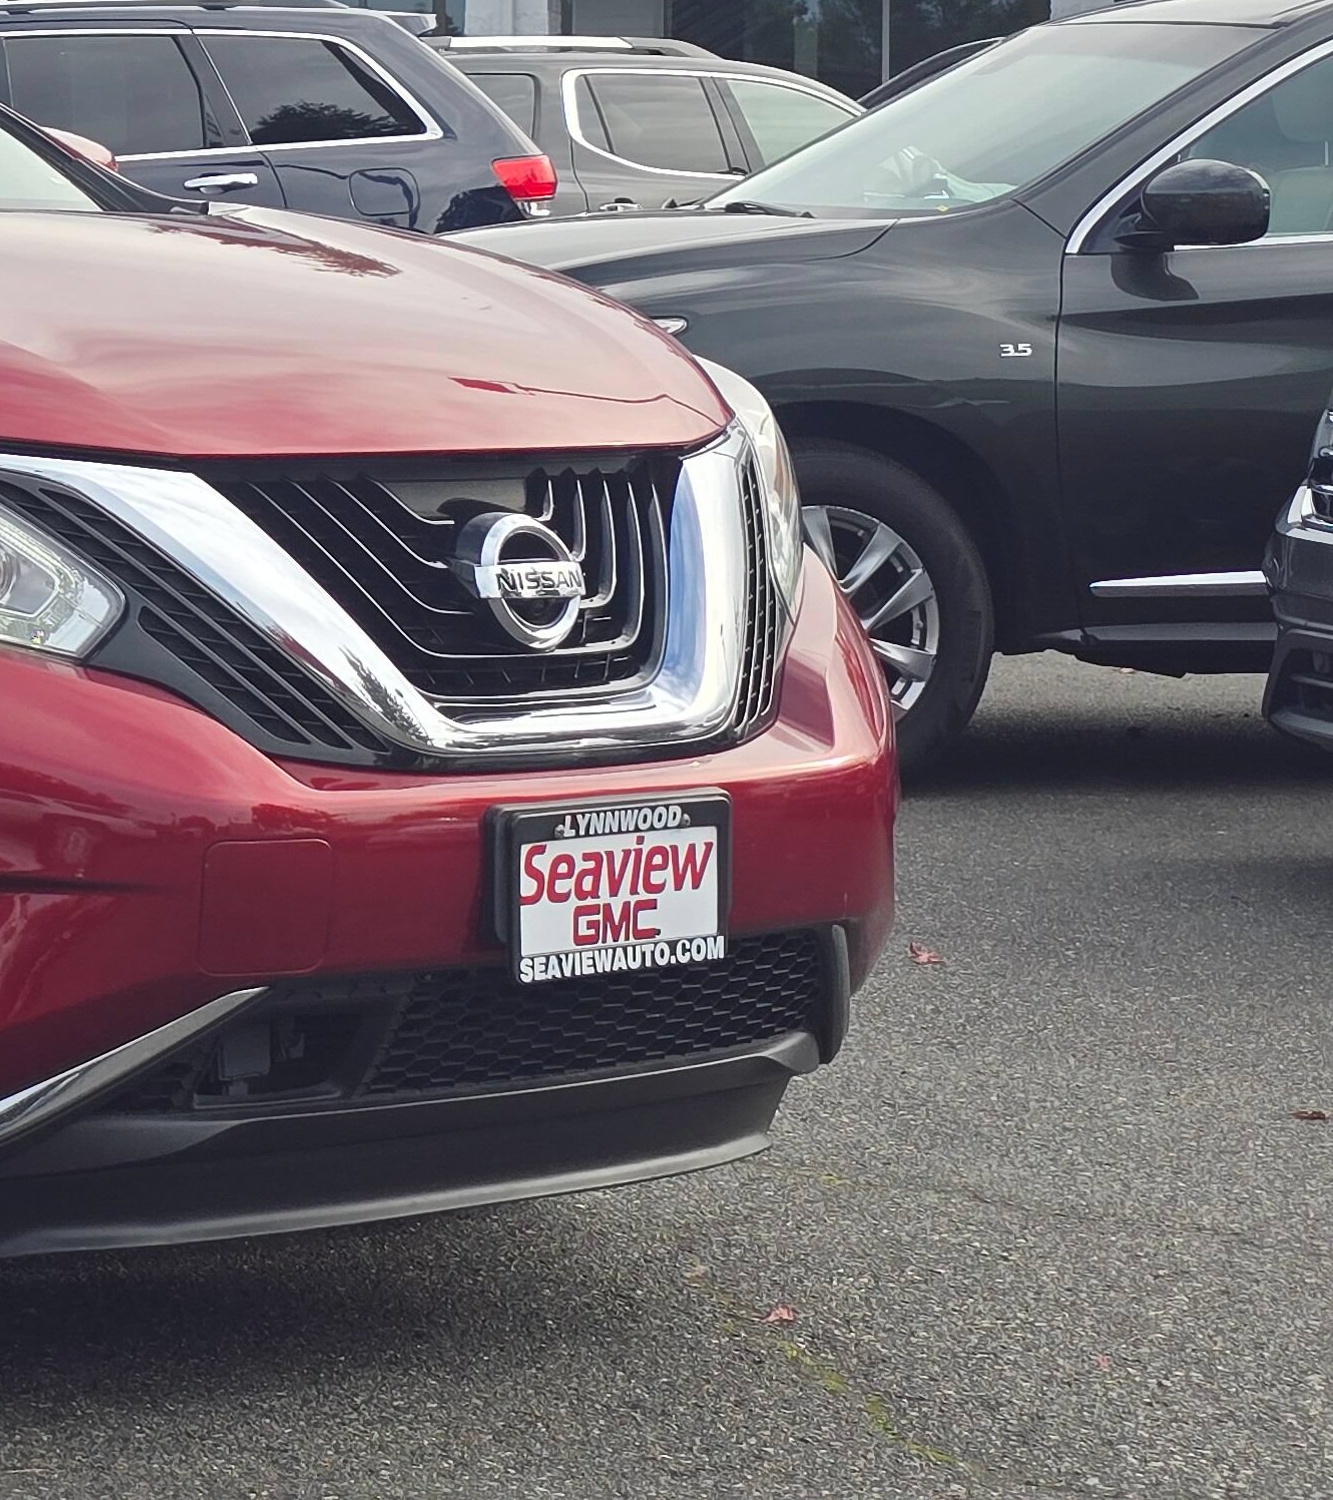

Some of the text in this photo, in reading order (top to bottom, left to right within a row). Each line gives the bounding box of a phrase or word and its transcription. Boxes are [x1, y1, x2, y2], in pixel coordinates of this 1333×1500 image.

[497, 570, 582, 590] NISSAN
[564, 805, 682, 837] LYNNWOOD
[520, 835, 714, 906] Seaview
[573, 898, 661, 946] GMC
[520, 936, 725, 983] SEAVIEWAUTO.COM
